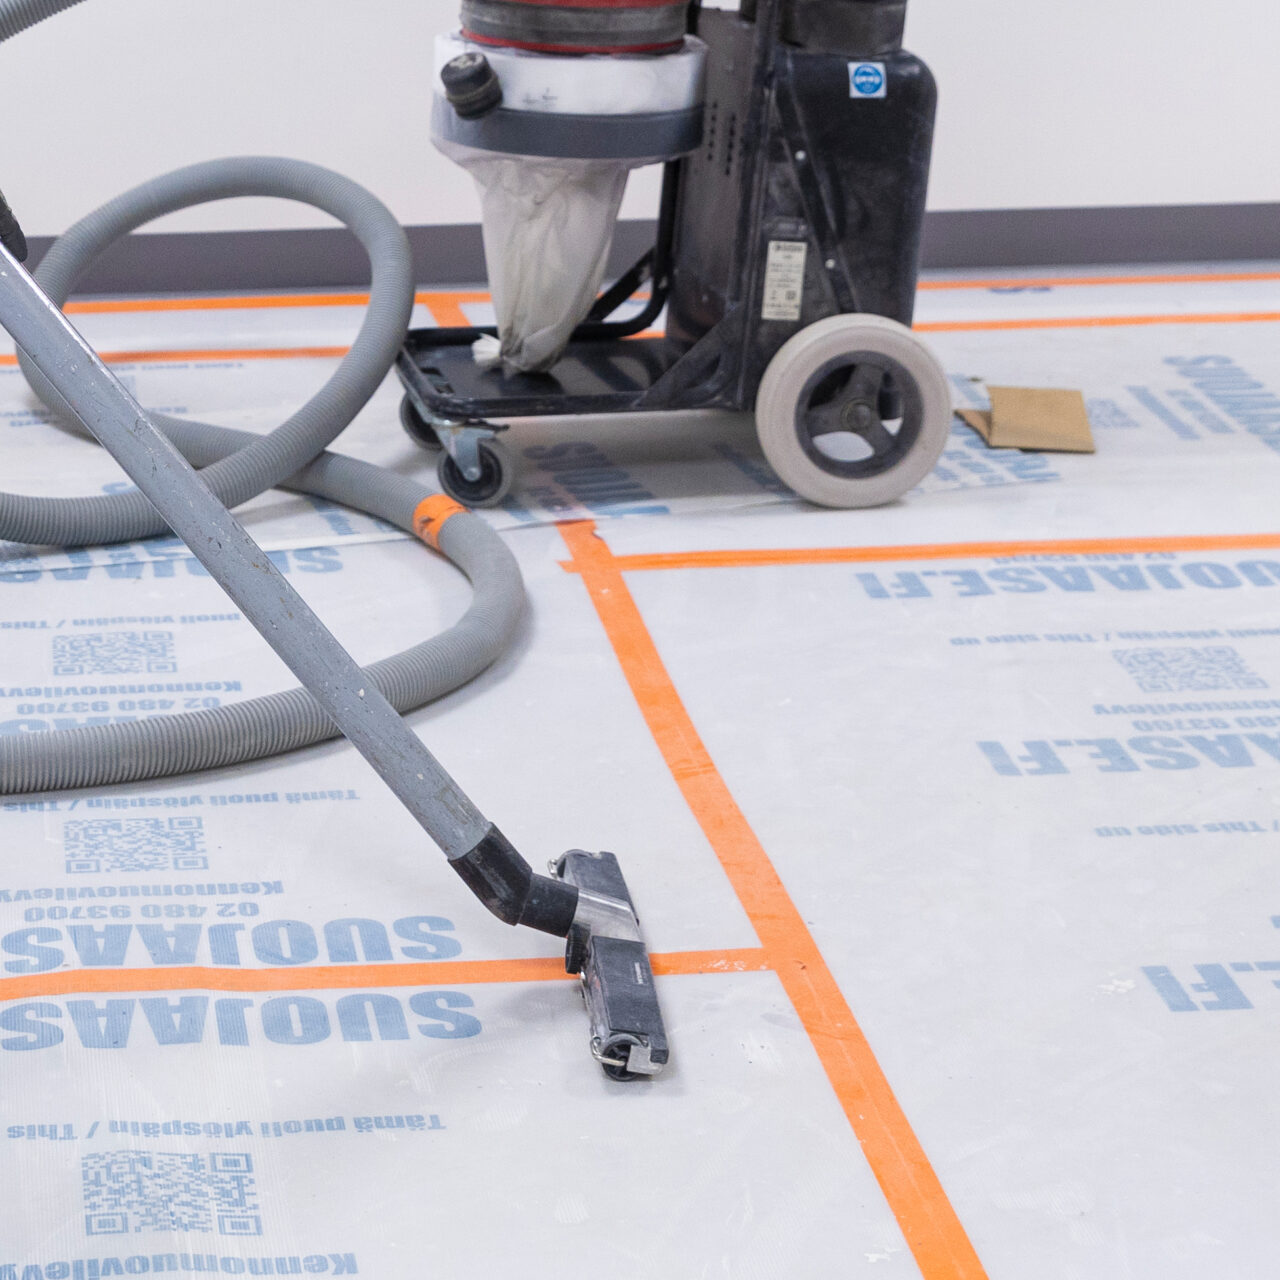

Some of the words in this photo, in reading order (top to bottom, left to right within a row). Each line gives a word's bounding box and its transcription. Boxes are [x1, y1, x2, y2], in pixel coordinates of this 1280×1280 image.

[16, 700, 110, 716] 93700
[117, 698, 177, 714] 480
[183, 696, 220, 711] 02
[87, 793, 204, 810] ylöspäin
[210, 790, 280, 806] puoli
[285, 789, 360, 804] Tämä
[3, 801, 61, 814] This
[24, 904, 131, 923] 93700
[139, 903, 209, 921] 480
[215, 901, 260, 919] 02
[6, 1123, 78, 1142] This
[108, 1120, 253, 1140] ylöspäin
[260, 1117, 345, 1138] puoli
[353, 1115, 446, 1134] Tämä
